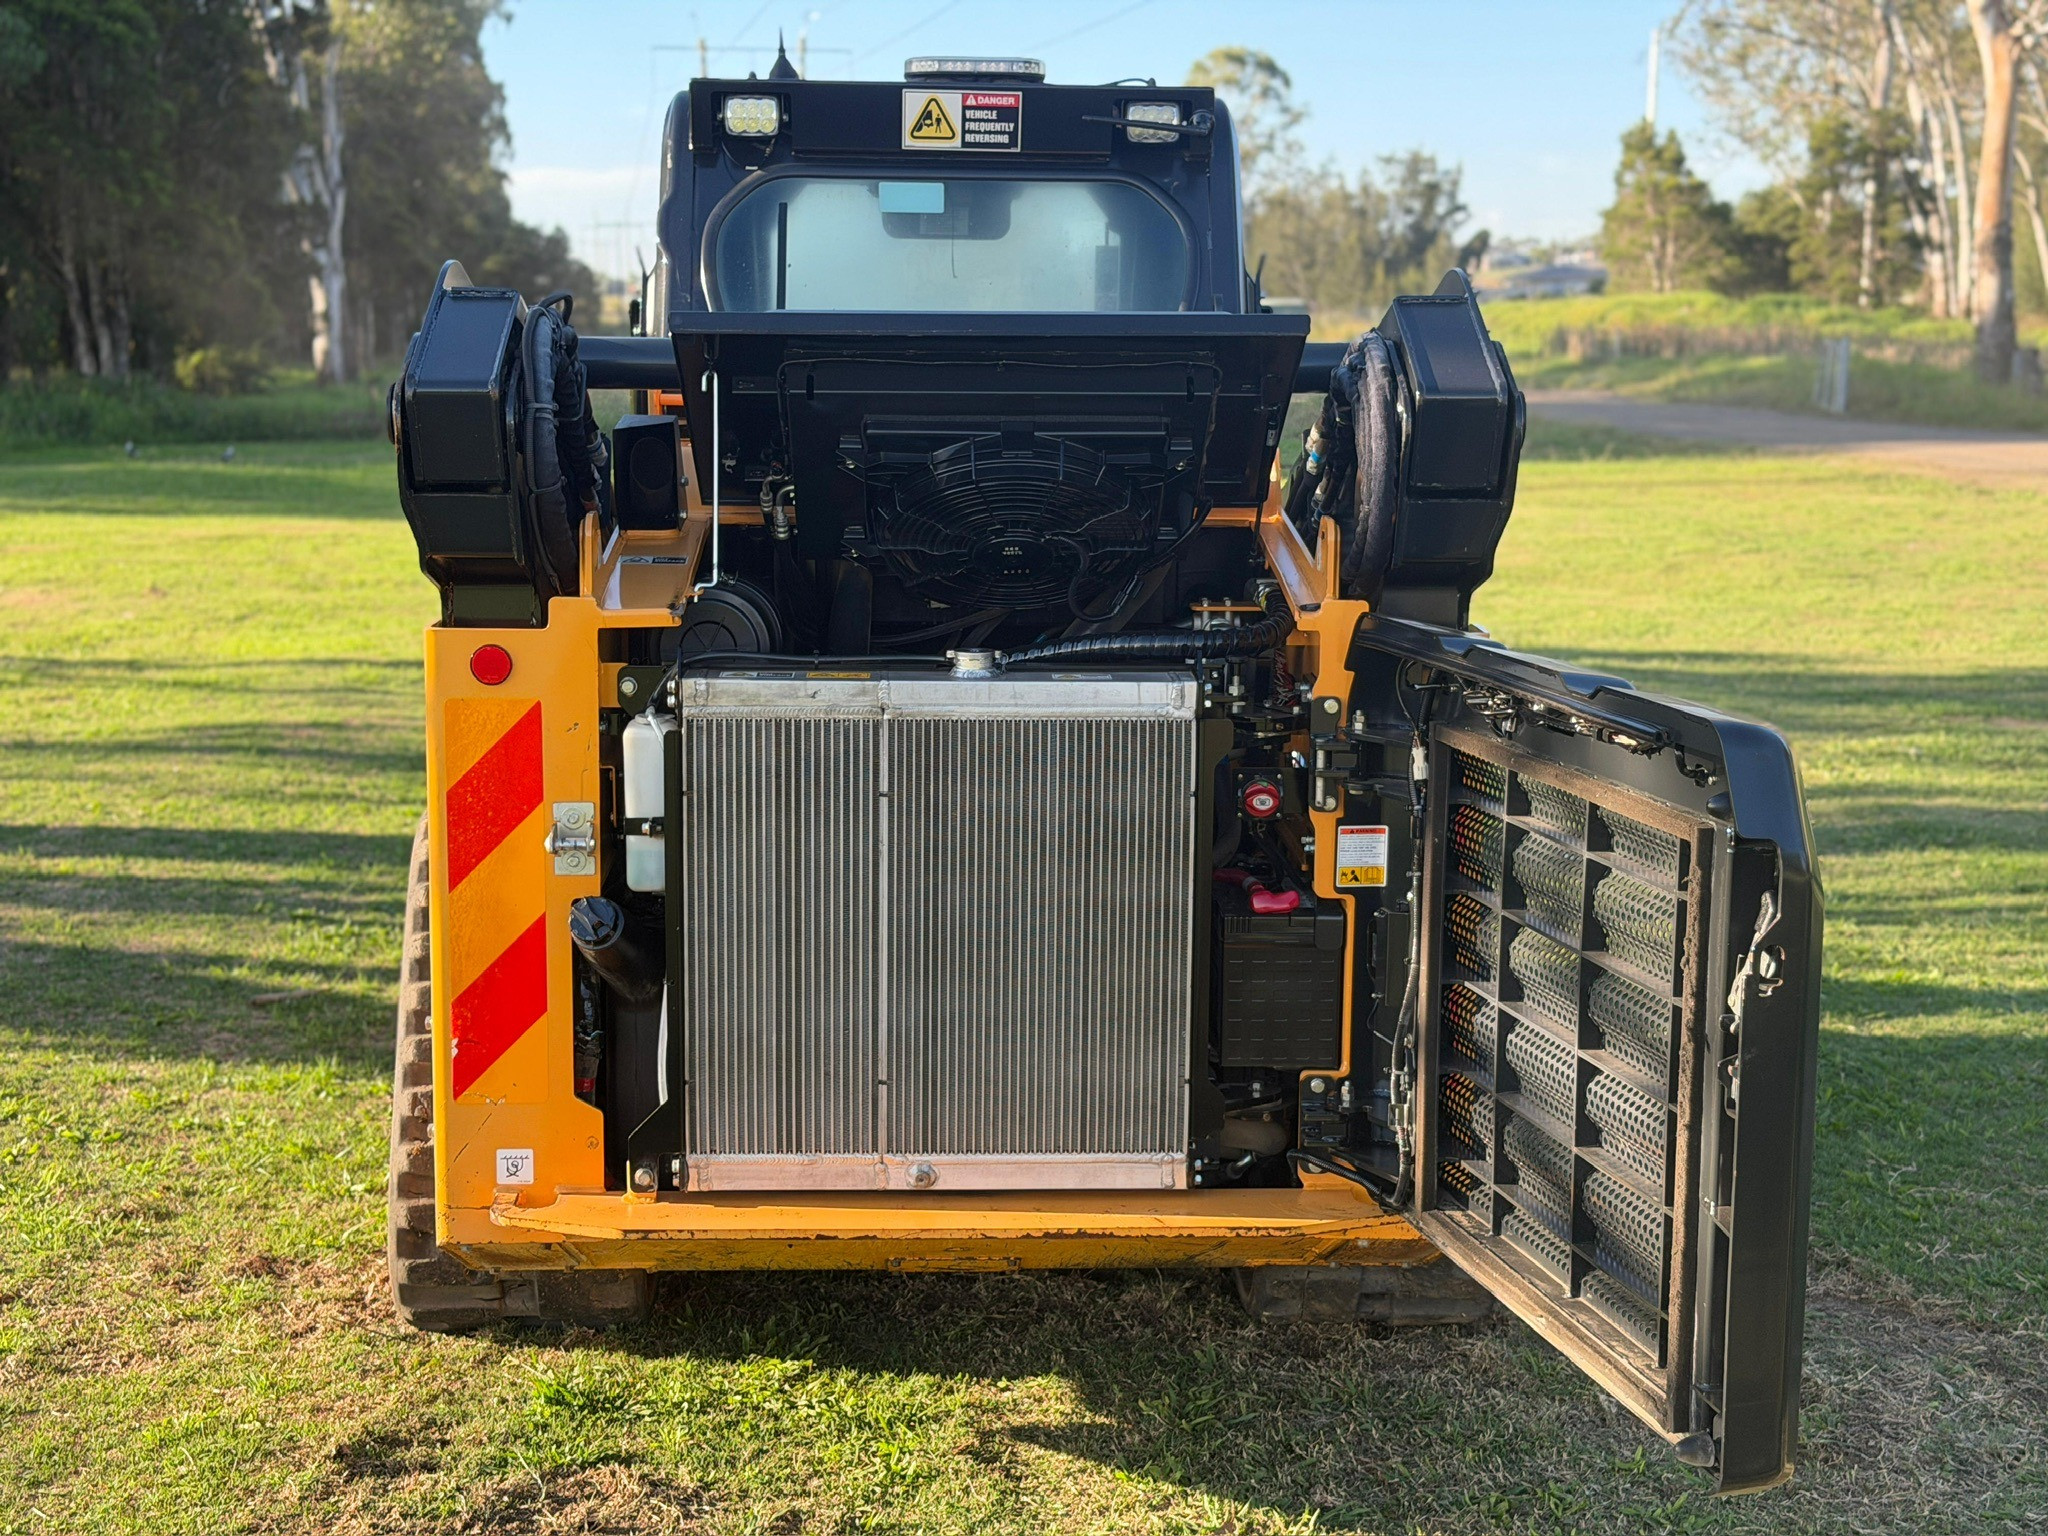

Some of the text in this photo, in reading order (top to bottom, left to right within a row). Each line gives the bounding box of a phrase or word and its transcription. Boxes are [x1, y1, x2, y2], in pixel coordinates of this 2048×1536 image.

[977, 96, 1015, 105] DANGER
[965, 109, 998, 119] VEHICLE
[965, 122, 1015, 132] FREQUENTLY
[964, 133, 1009, 144] REVERSING
